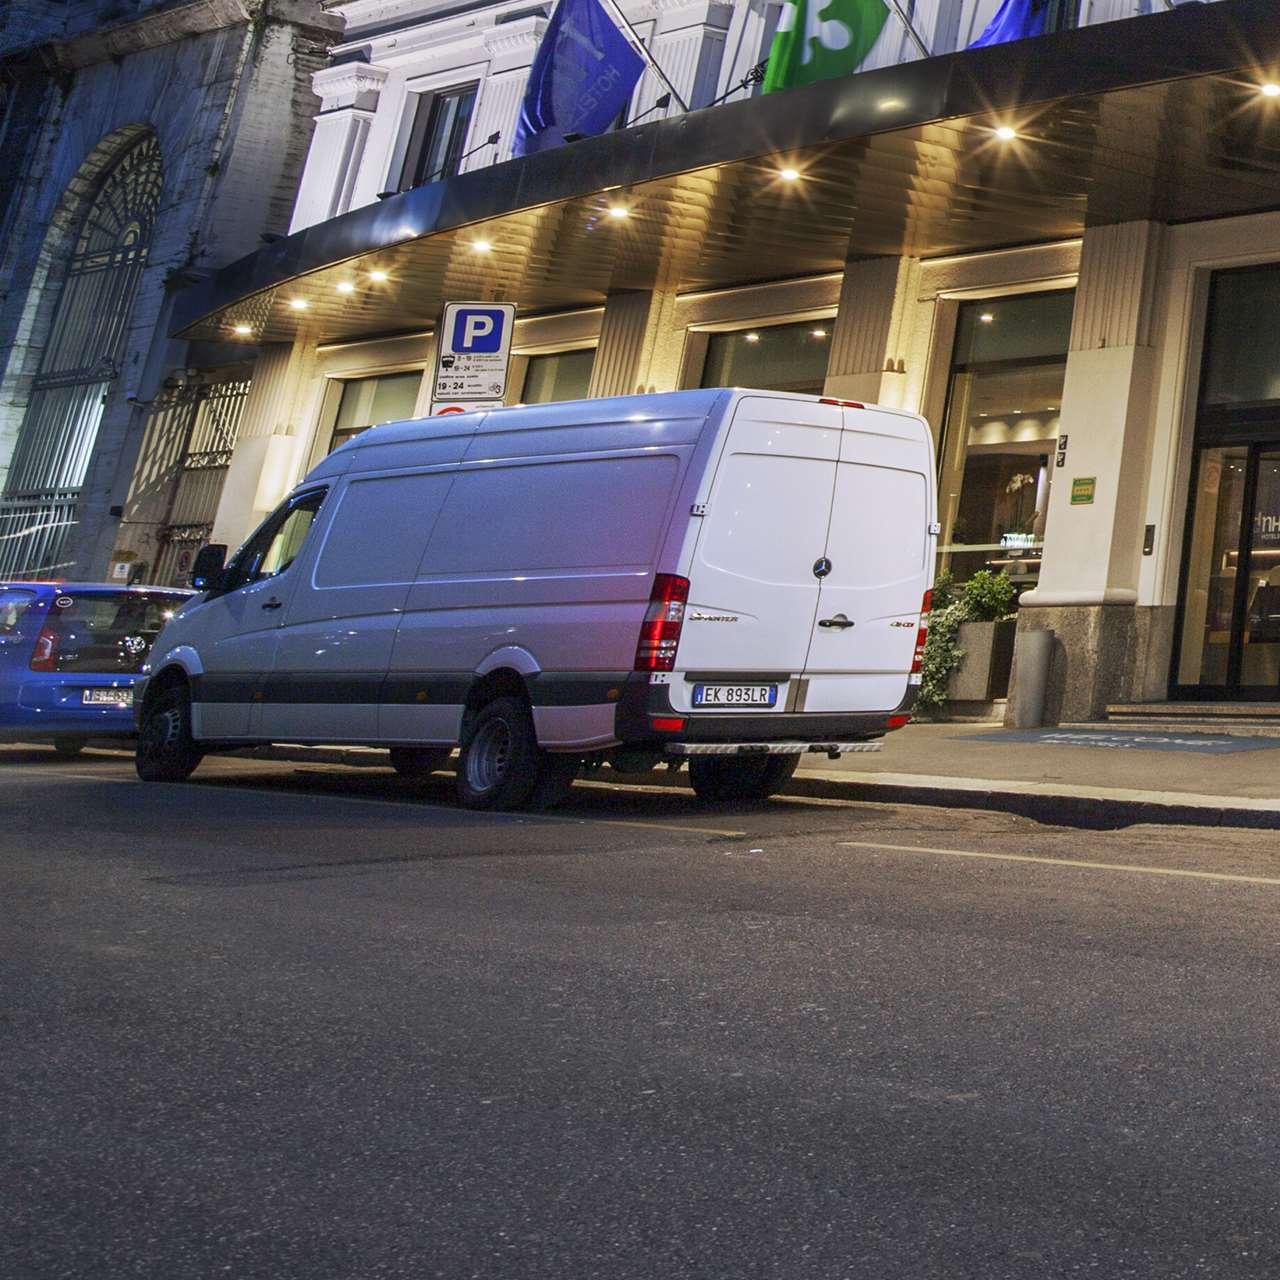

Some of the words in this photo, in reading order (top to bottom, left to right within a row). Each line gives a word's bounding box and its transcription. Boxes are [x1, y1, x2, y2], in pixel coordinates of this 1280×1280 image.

[463, 315, 494, 348] P
[438, 382, 447, 390] 19
[454, 382, 464, 390] 24
[704, 687, 721, 702] EK
[726, 687, 767, 702] 893LR
